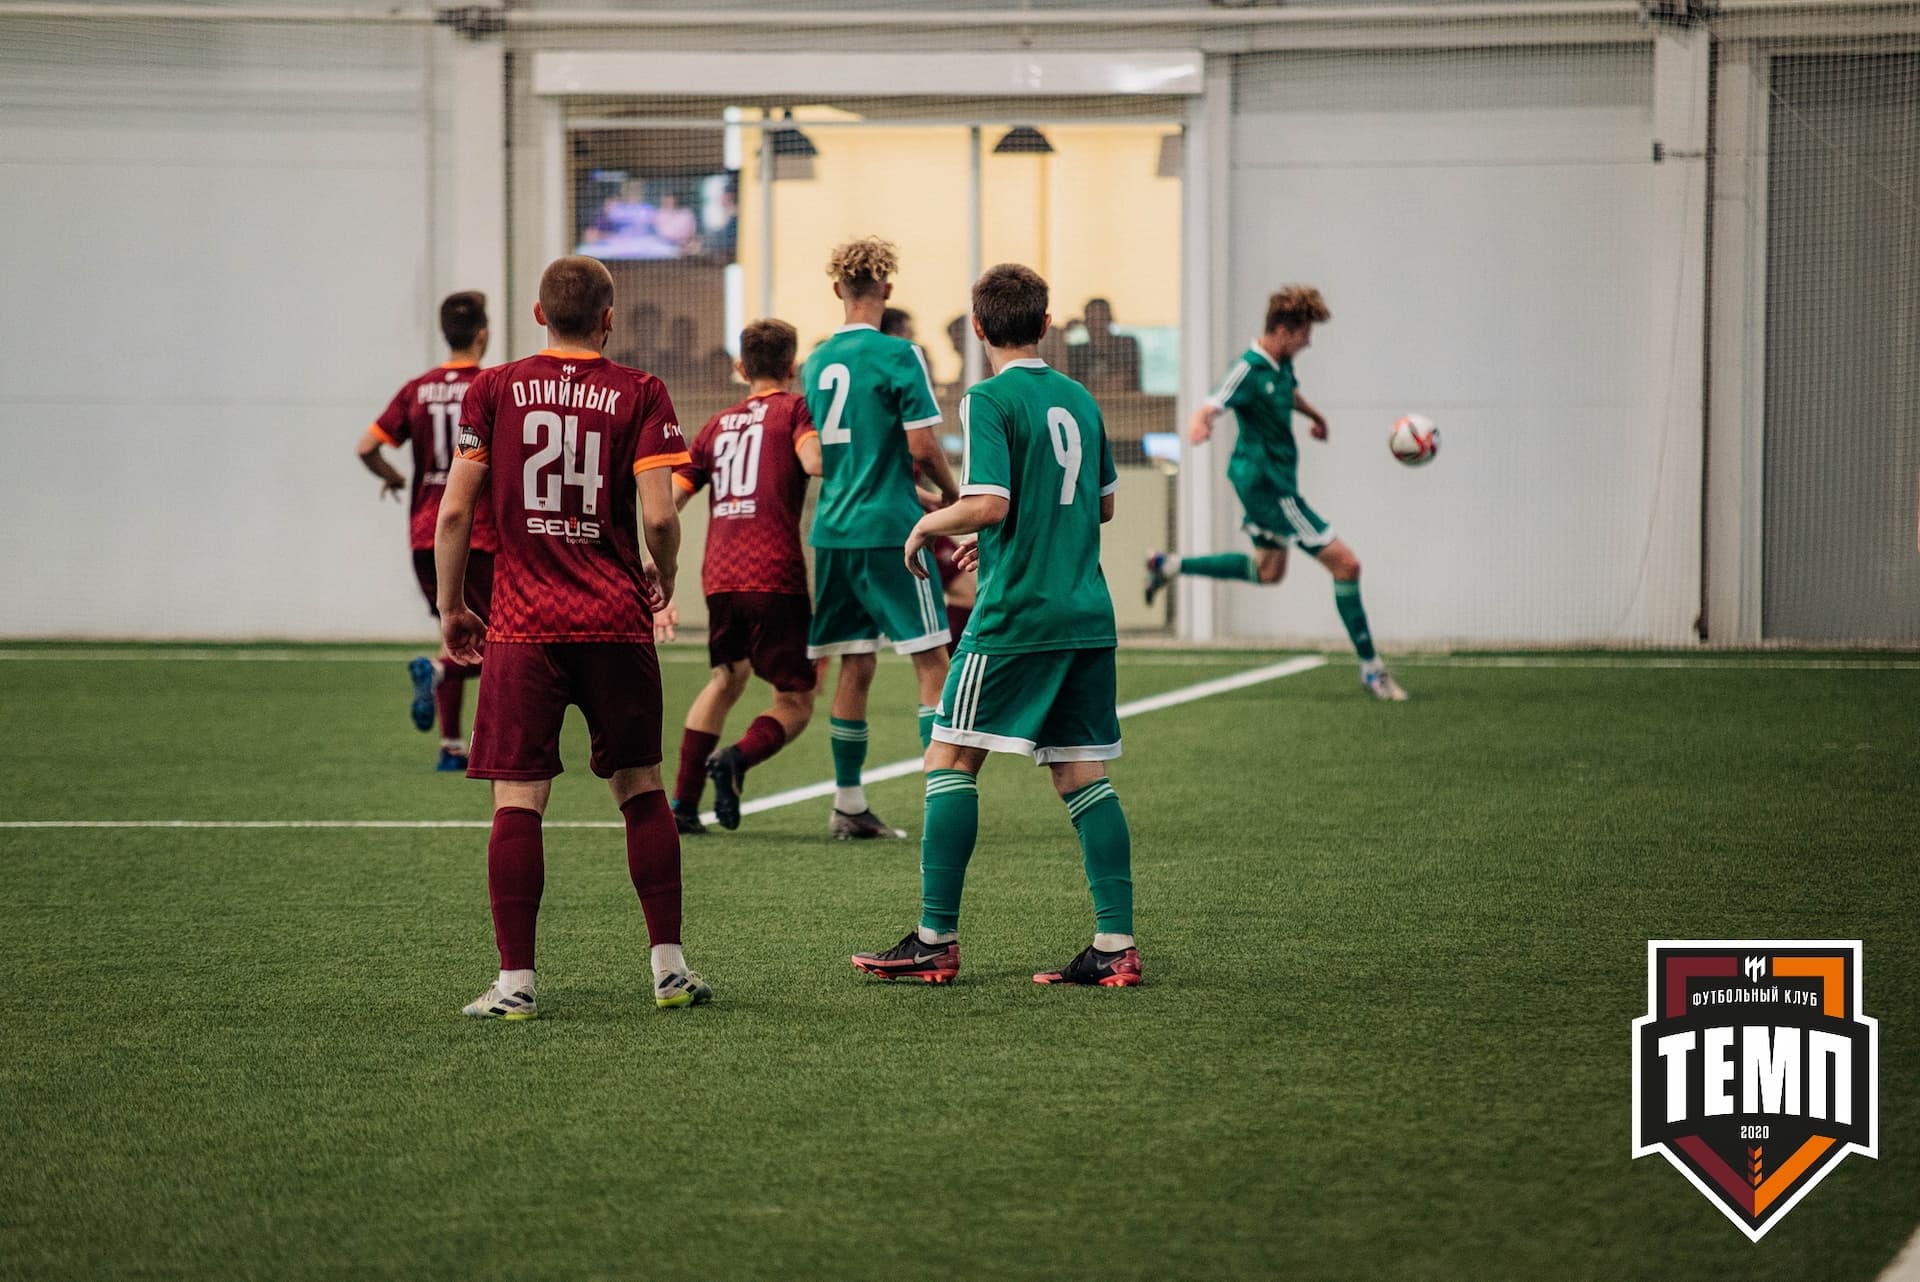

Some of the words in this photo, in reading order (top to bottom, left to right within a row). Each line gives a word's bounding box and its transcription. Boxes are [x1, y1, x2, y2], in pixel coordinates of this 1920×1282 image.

[512, 375, 622, 416] ОЛИЙНЫК
[818, 362, 852, 445] 2
[522, 410, 604, 516] 24
[711, 423, 764, 502] 30
[1047, 406, 1082, 505] 9
[526, 517, 601, 539] SEUS
